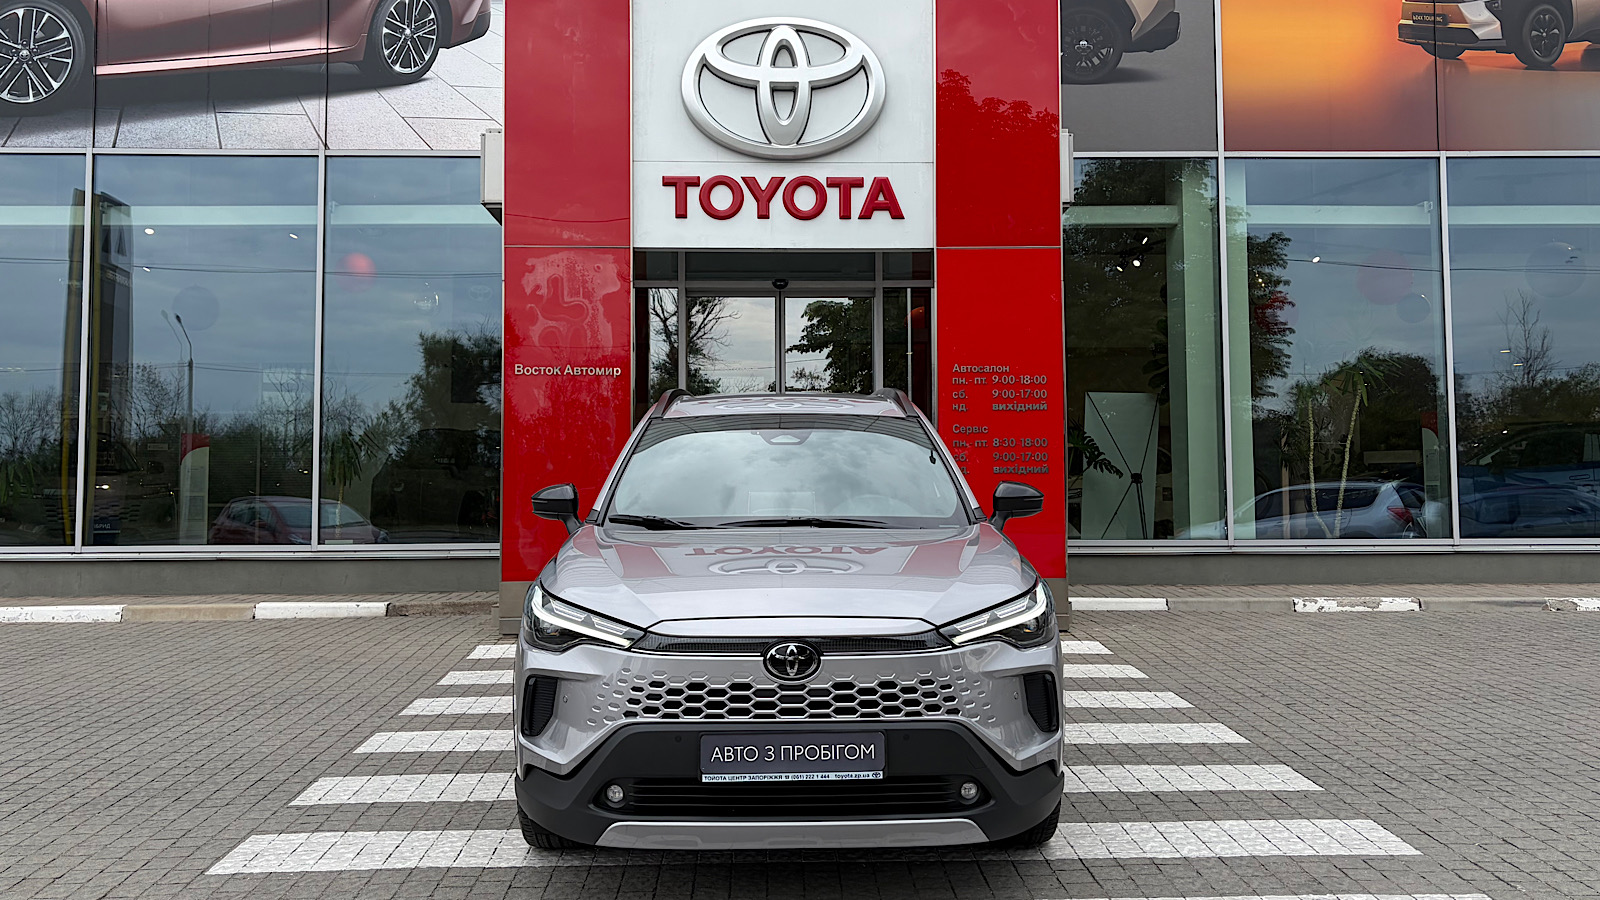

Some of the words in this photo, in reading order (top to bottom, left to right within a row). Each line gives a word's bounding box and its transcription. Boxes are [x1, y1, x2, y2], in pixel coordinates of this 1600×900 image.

[662, 175, 905, 220] TOYOTA
[514, 364, 561, 375] Восток
[563, 364, 621, 378] Автомир
[952, 363, 1010, 373] Автосалон
[952, 389, 968, 399] сб.
[992, 389, 1047, 399] 9:00-17:00
[952, 403, 968, 412] нд.
[992, 401, 1047, 412] вихідний
[952, 424, 989, 435] Сервіс
[992, 452, 1048, 462] 9:00-17:00
[993, 464, 1049, 475] вихідний
[710, 746, 759, 762] АВТО
[780, 744, 876, 761] ПРОБІГОМ
